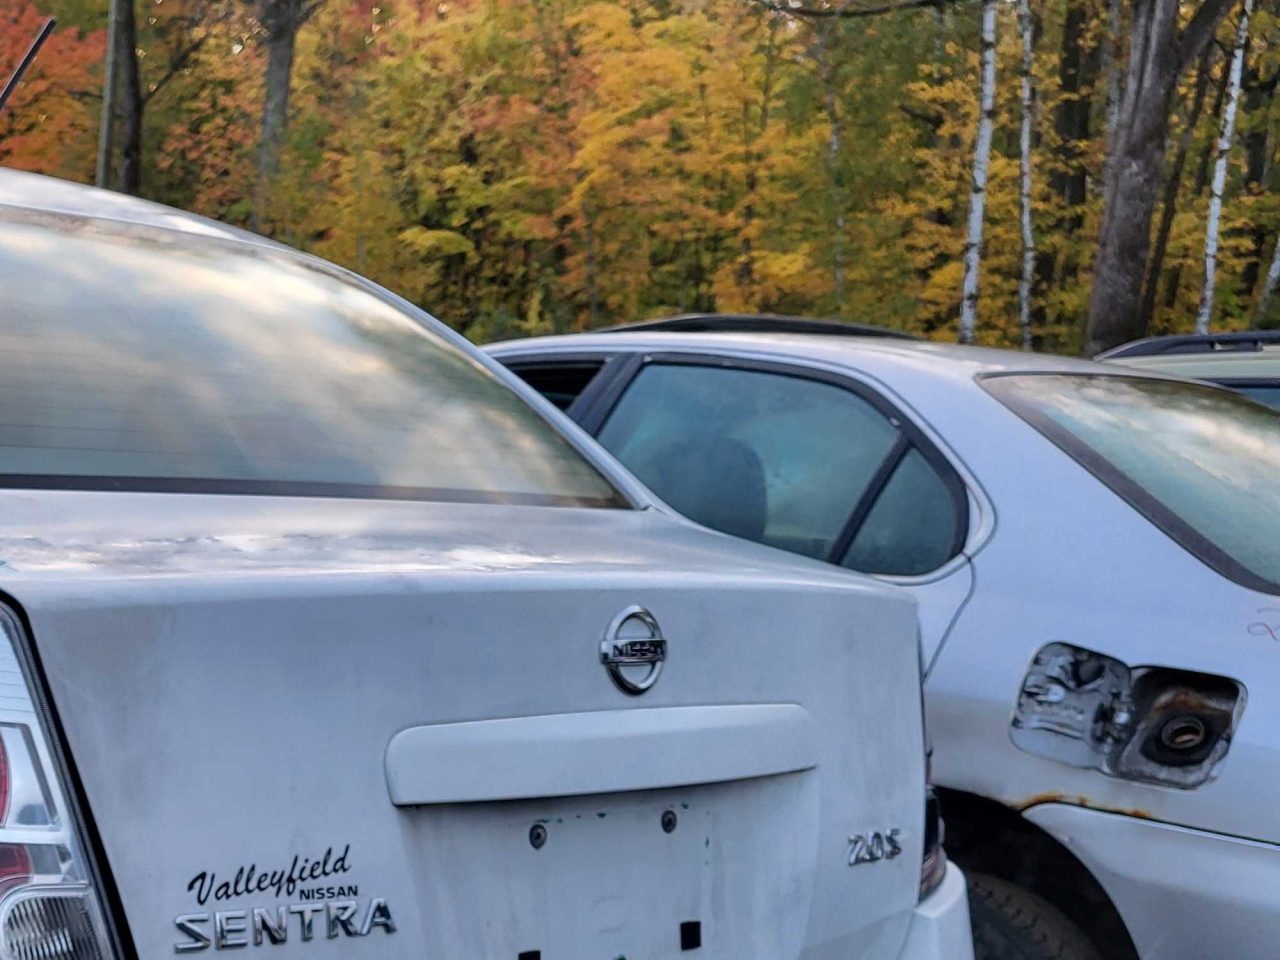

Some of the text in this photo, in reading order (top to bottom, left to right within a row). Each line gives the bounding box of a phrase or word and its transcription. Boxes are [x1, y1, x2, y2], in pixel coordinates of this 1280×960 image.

[187, 844, 351, 906] Valleyfield
[299, 885, 358, 901] NISSAN
[173, 897, 398, 953] SENTRA
